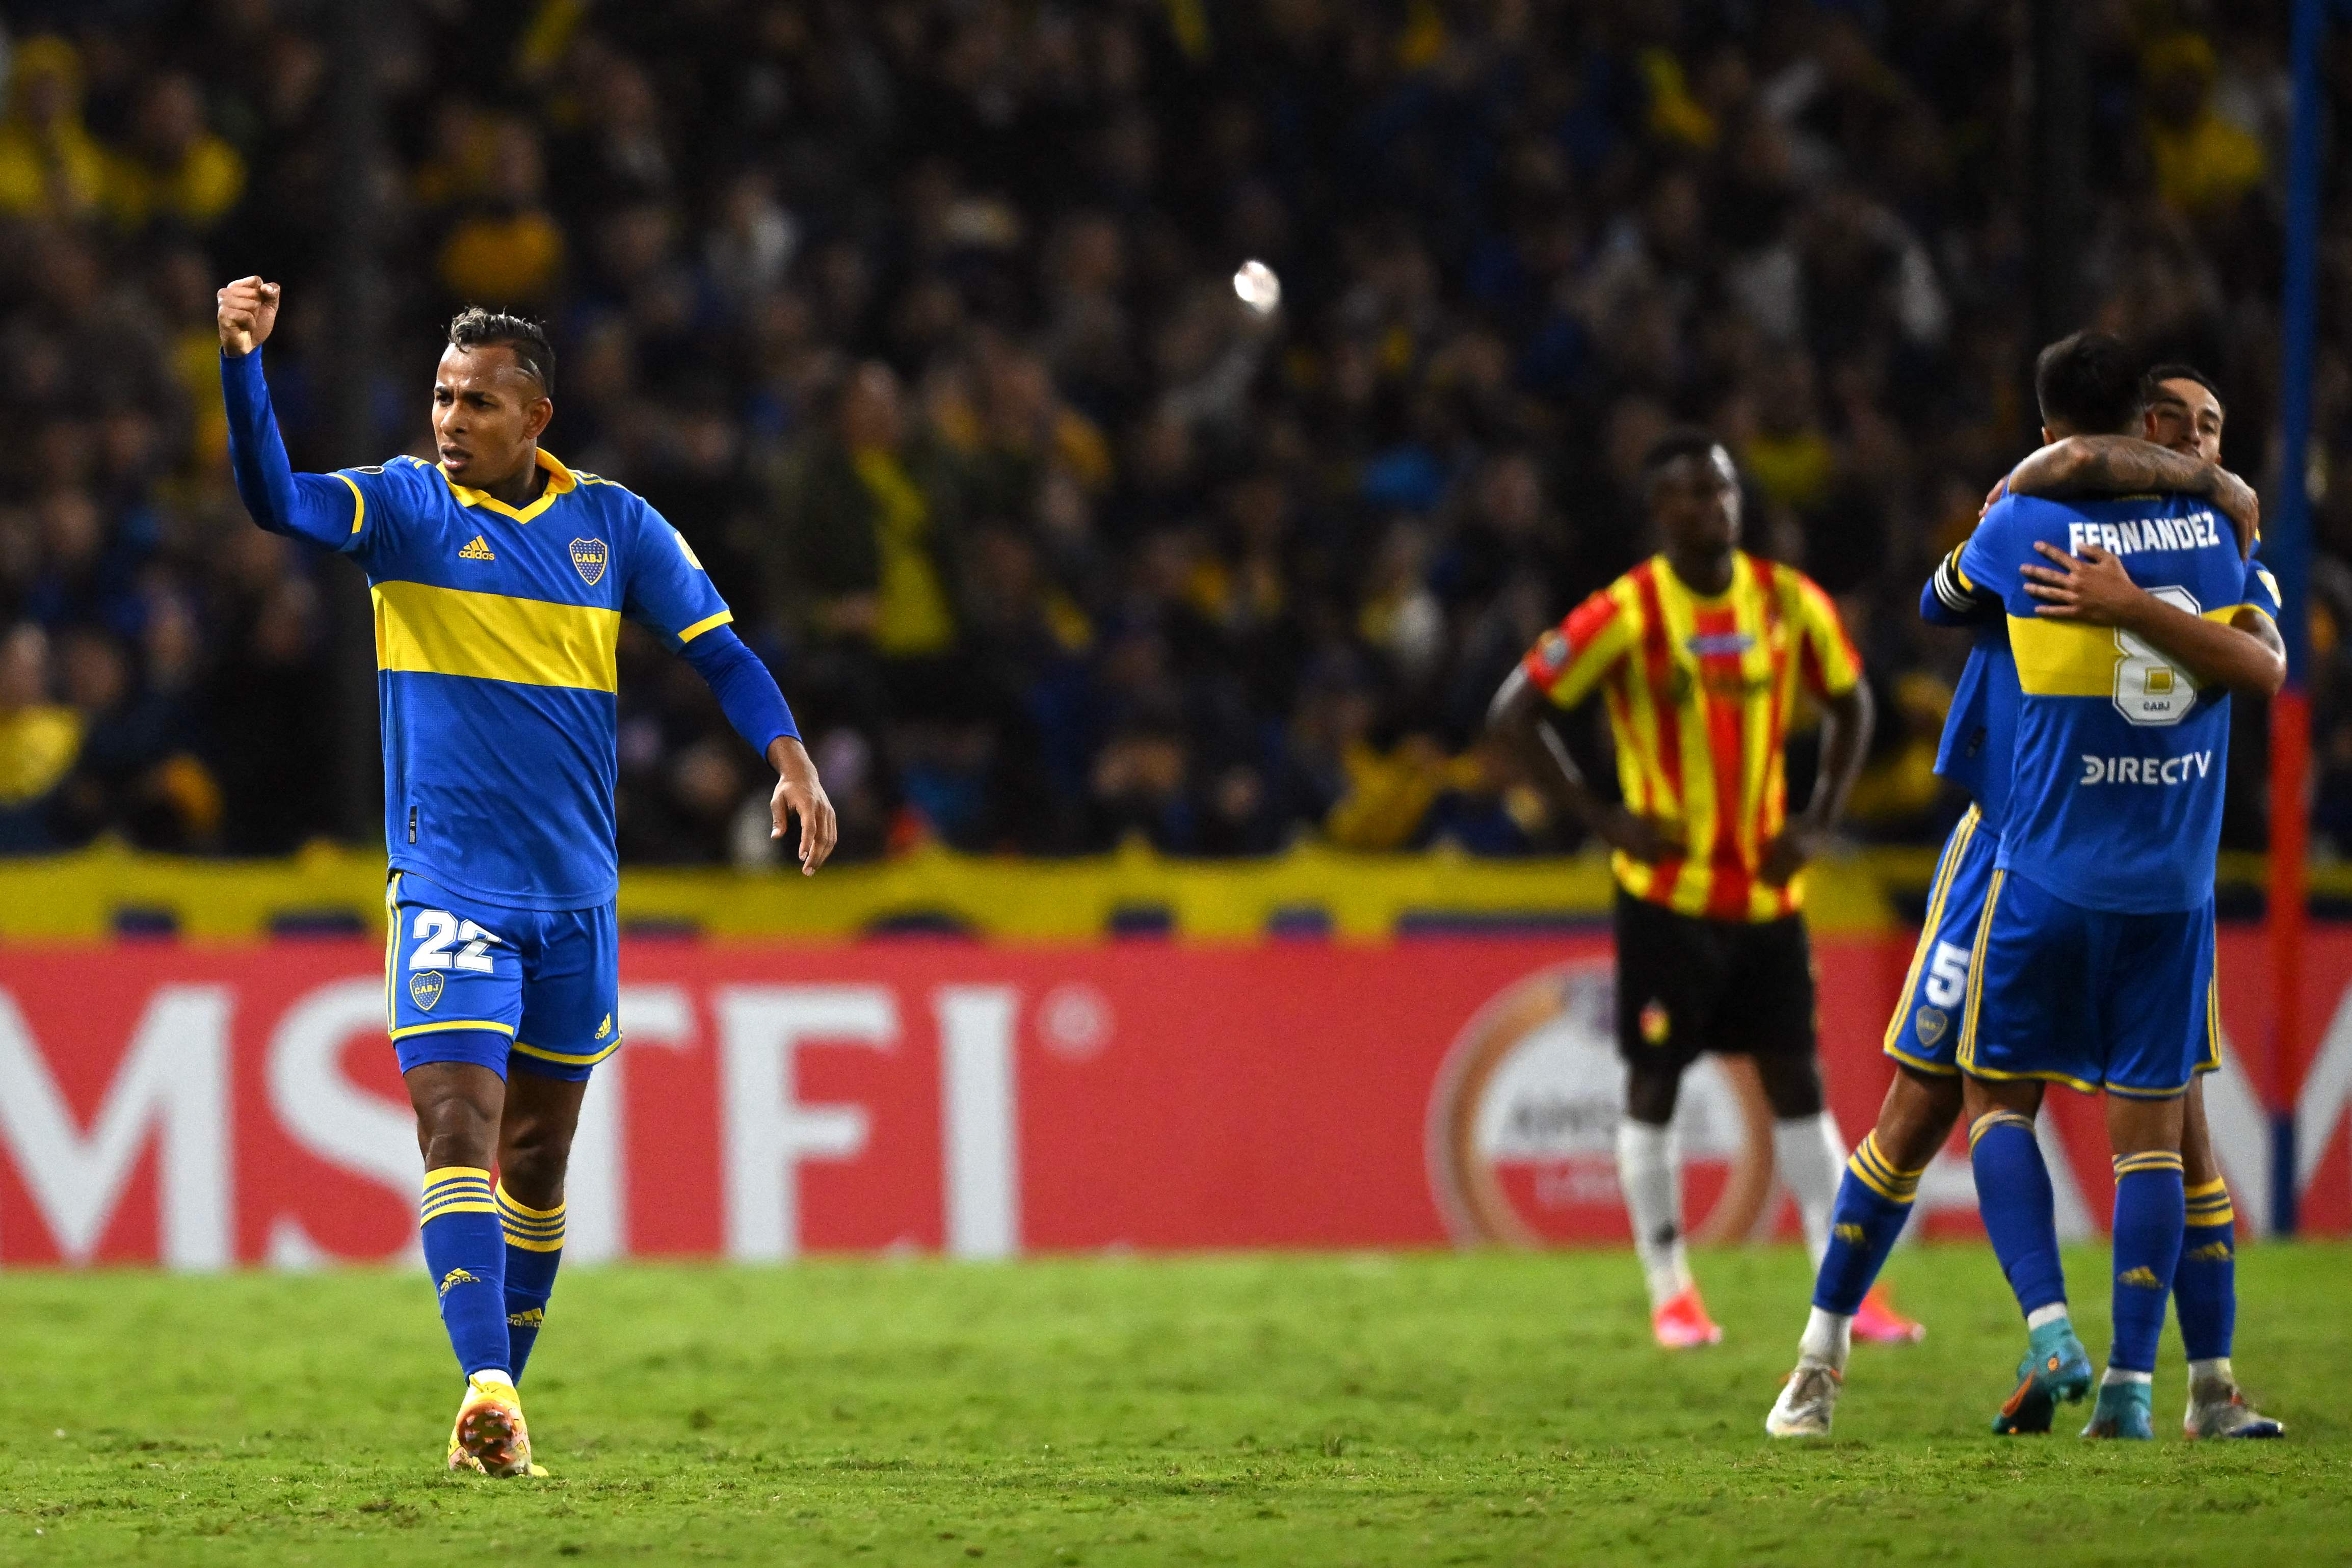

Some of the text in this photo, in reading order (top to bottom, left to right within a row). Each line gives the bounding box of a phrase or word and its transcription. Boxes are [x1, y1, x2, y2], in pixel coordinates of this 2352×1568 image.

[2068, 511, 2220, 557] FERNANDEZ
[458, 549, 495, 561] adidas
[575, 553, 603, 563] CABJ
[2143, 701, 2171, 711] CABJ
[2080, 749, 2212, 785] DIRECTV
[409, 909, 502, 973] 22
[1924, 939, 1971, 1009] 5
[414, 984, 439, 995] CABJ
